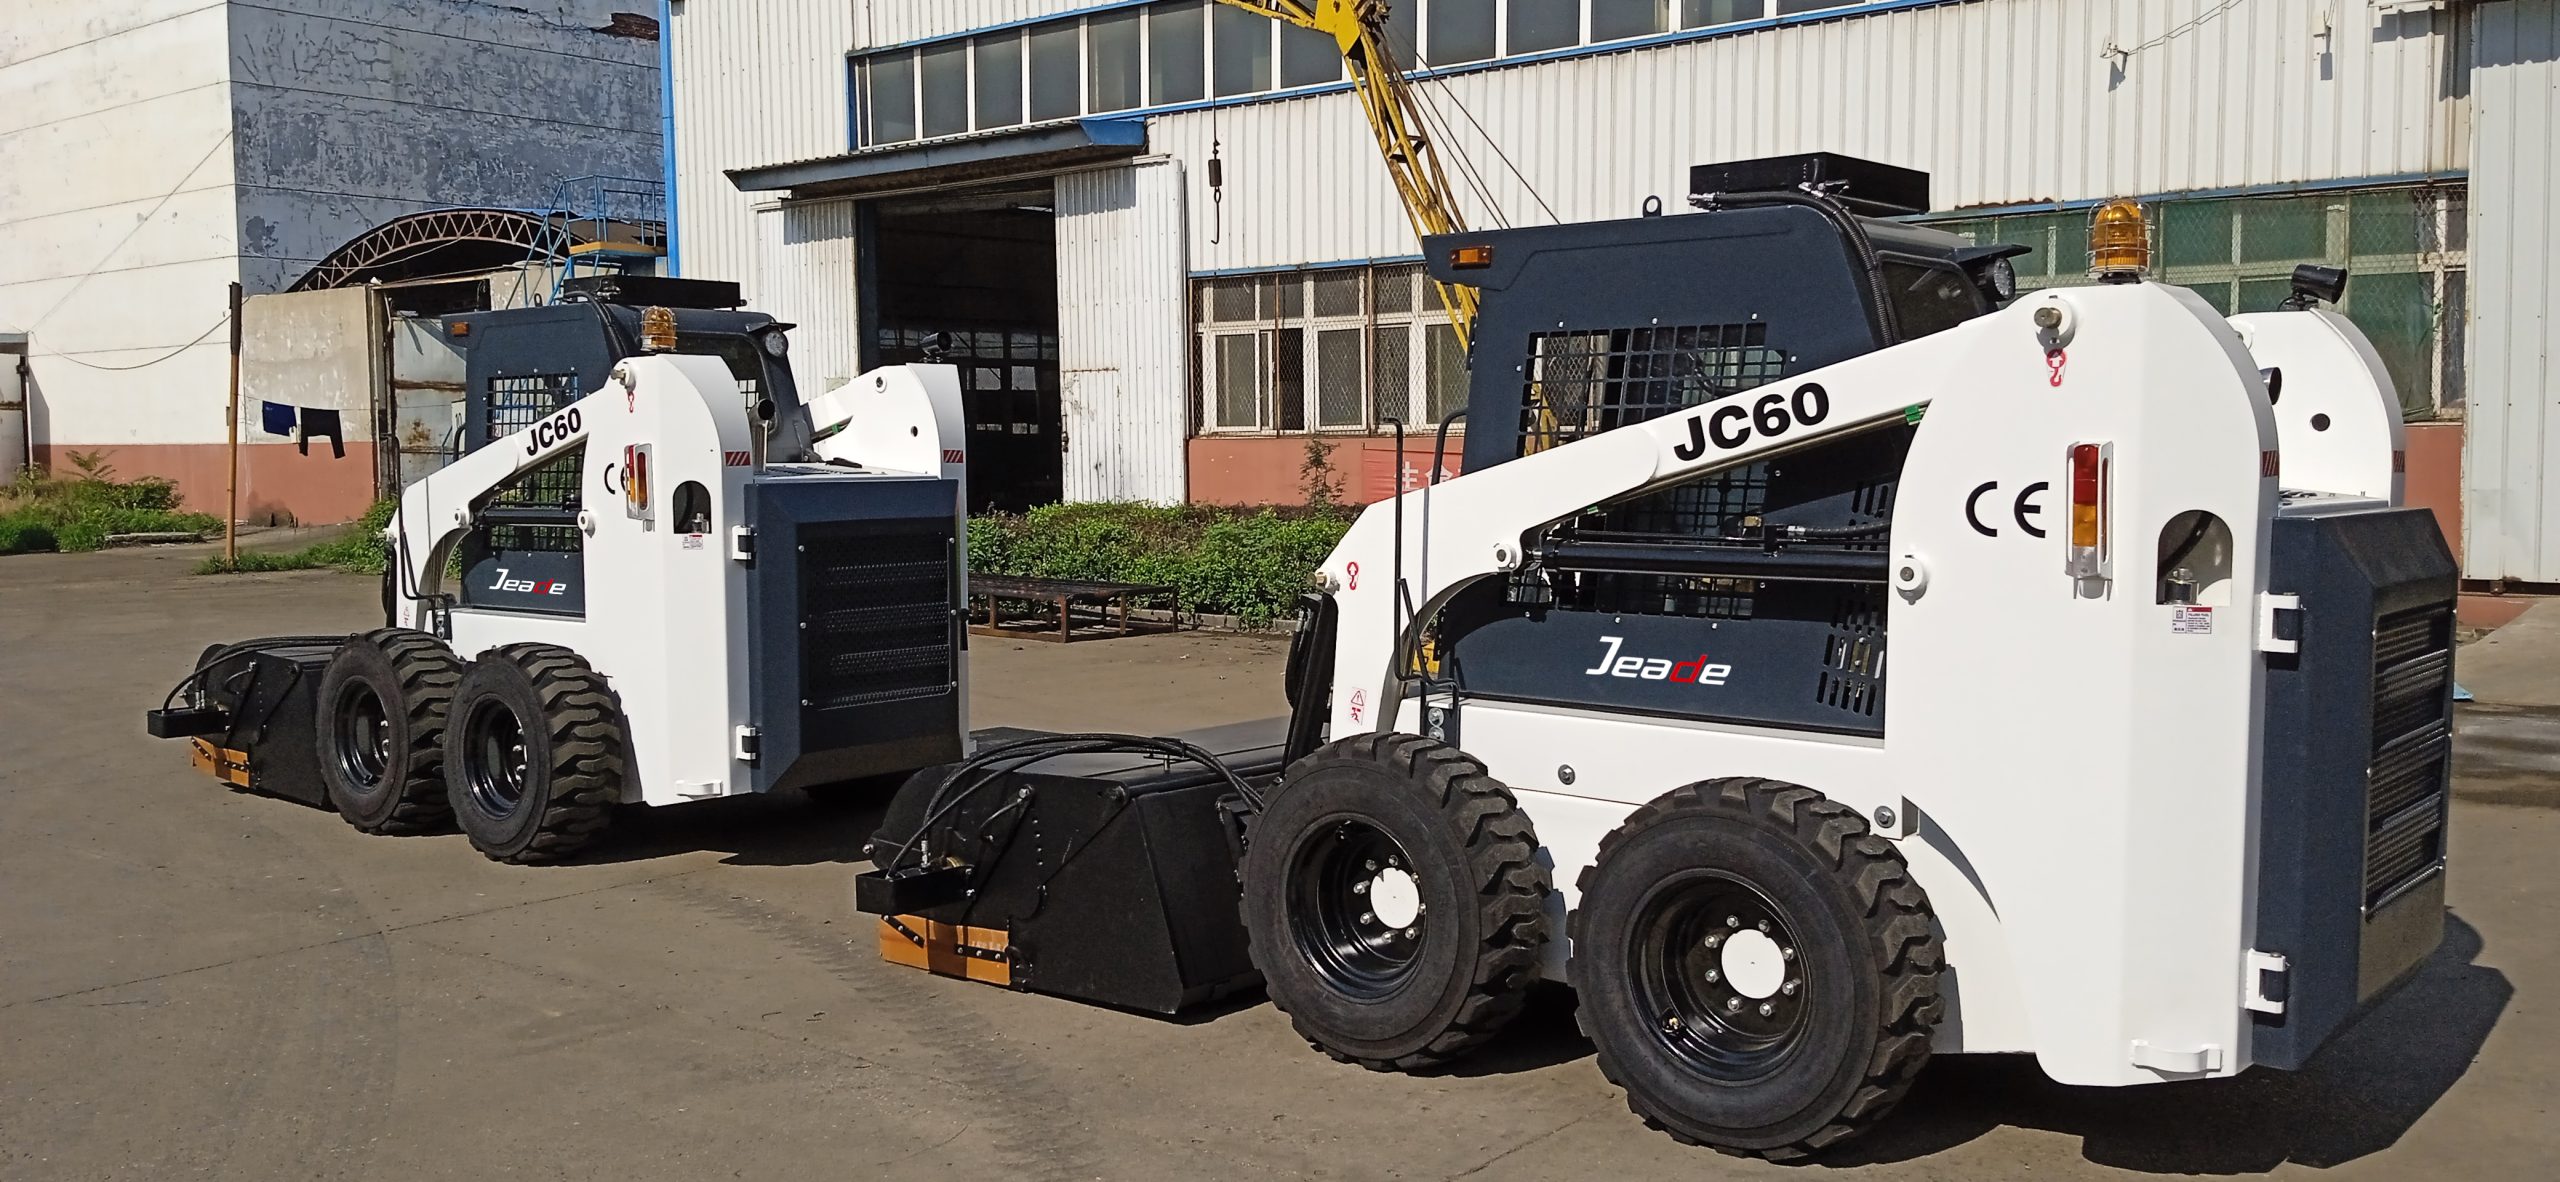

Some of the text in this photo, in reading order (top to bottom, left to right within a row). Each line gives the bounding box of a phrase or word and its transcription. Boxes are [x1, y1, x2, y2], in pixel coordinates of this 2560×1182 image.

[526, 407, 582, 457] JC60
[1673, 382, 1830, 461] JC60
[1965, 480, 2049, 539] CE
[488, 567, 567, 595] Jeade
[1585, 635, 1732, 686] Jeade
